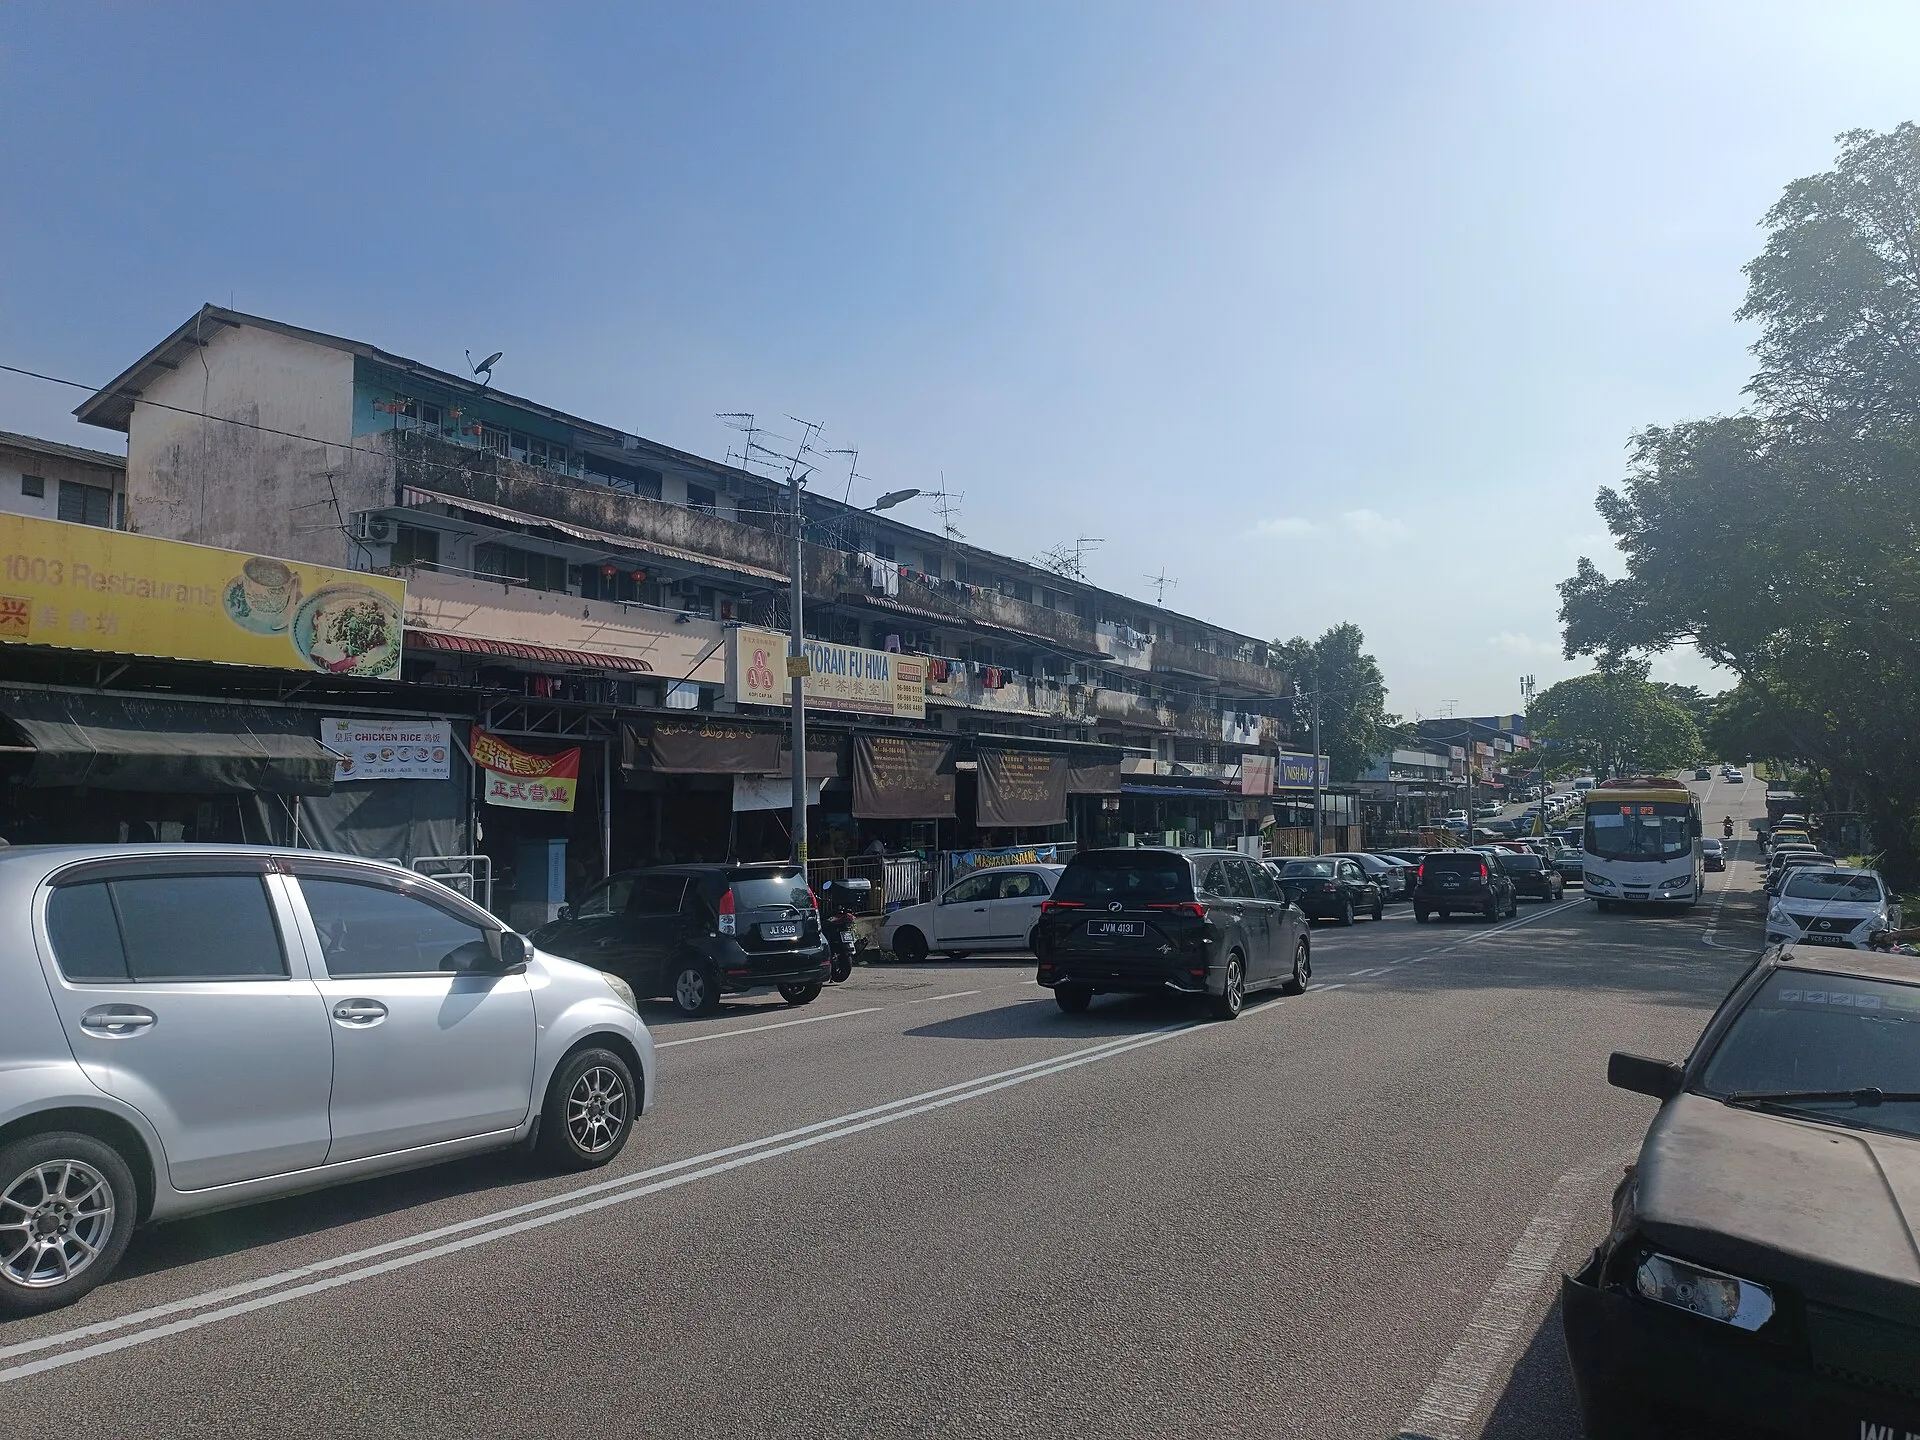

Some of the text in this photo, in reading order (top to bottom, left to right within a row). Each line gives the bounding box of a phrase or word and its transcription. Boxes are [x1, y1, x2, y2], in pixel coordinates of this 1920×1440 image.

[5, 554, 216, 606] 1003 Restaurant
[849, 651, 862, 678] FU
[866, 654, 889, 681] HWA
[355, 733, 398, 741] CHICKEN
[401, 733, 421, 741] RICE
[490, 781, 569, 804] 正式营业
[1100, 923, 1134, 933] JVM 4131
